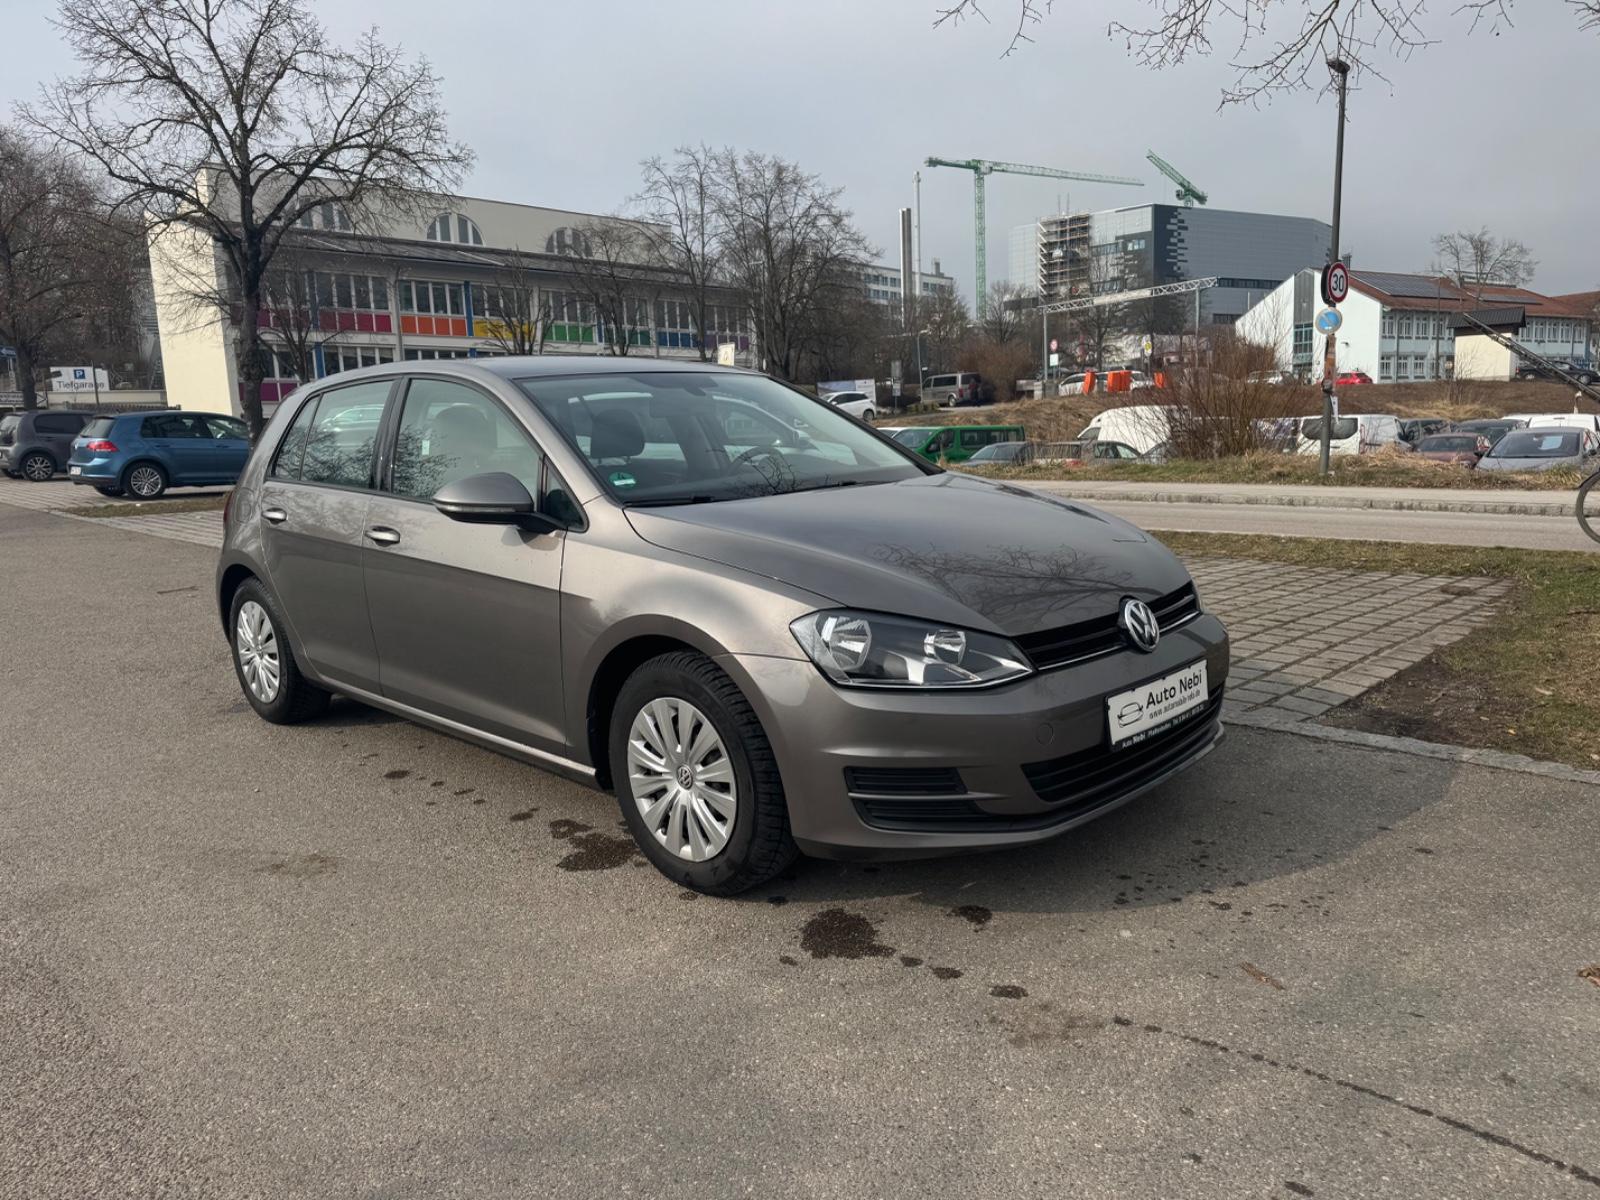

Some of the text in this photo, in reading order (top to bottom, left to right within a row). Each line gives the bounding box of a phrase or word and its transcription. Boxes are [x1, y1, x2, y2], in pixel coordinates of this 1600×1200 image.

[1332, 273, 1345, 292] 30
[56, 380, 104, 391] Tiefgarae
[1146, 669, 1202, 710] Auto Nebi
